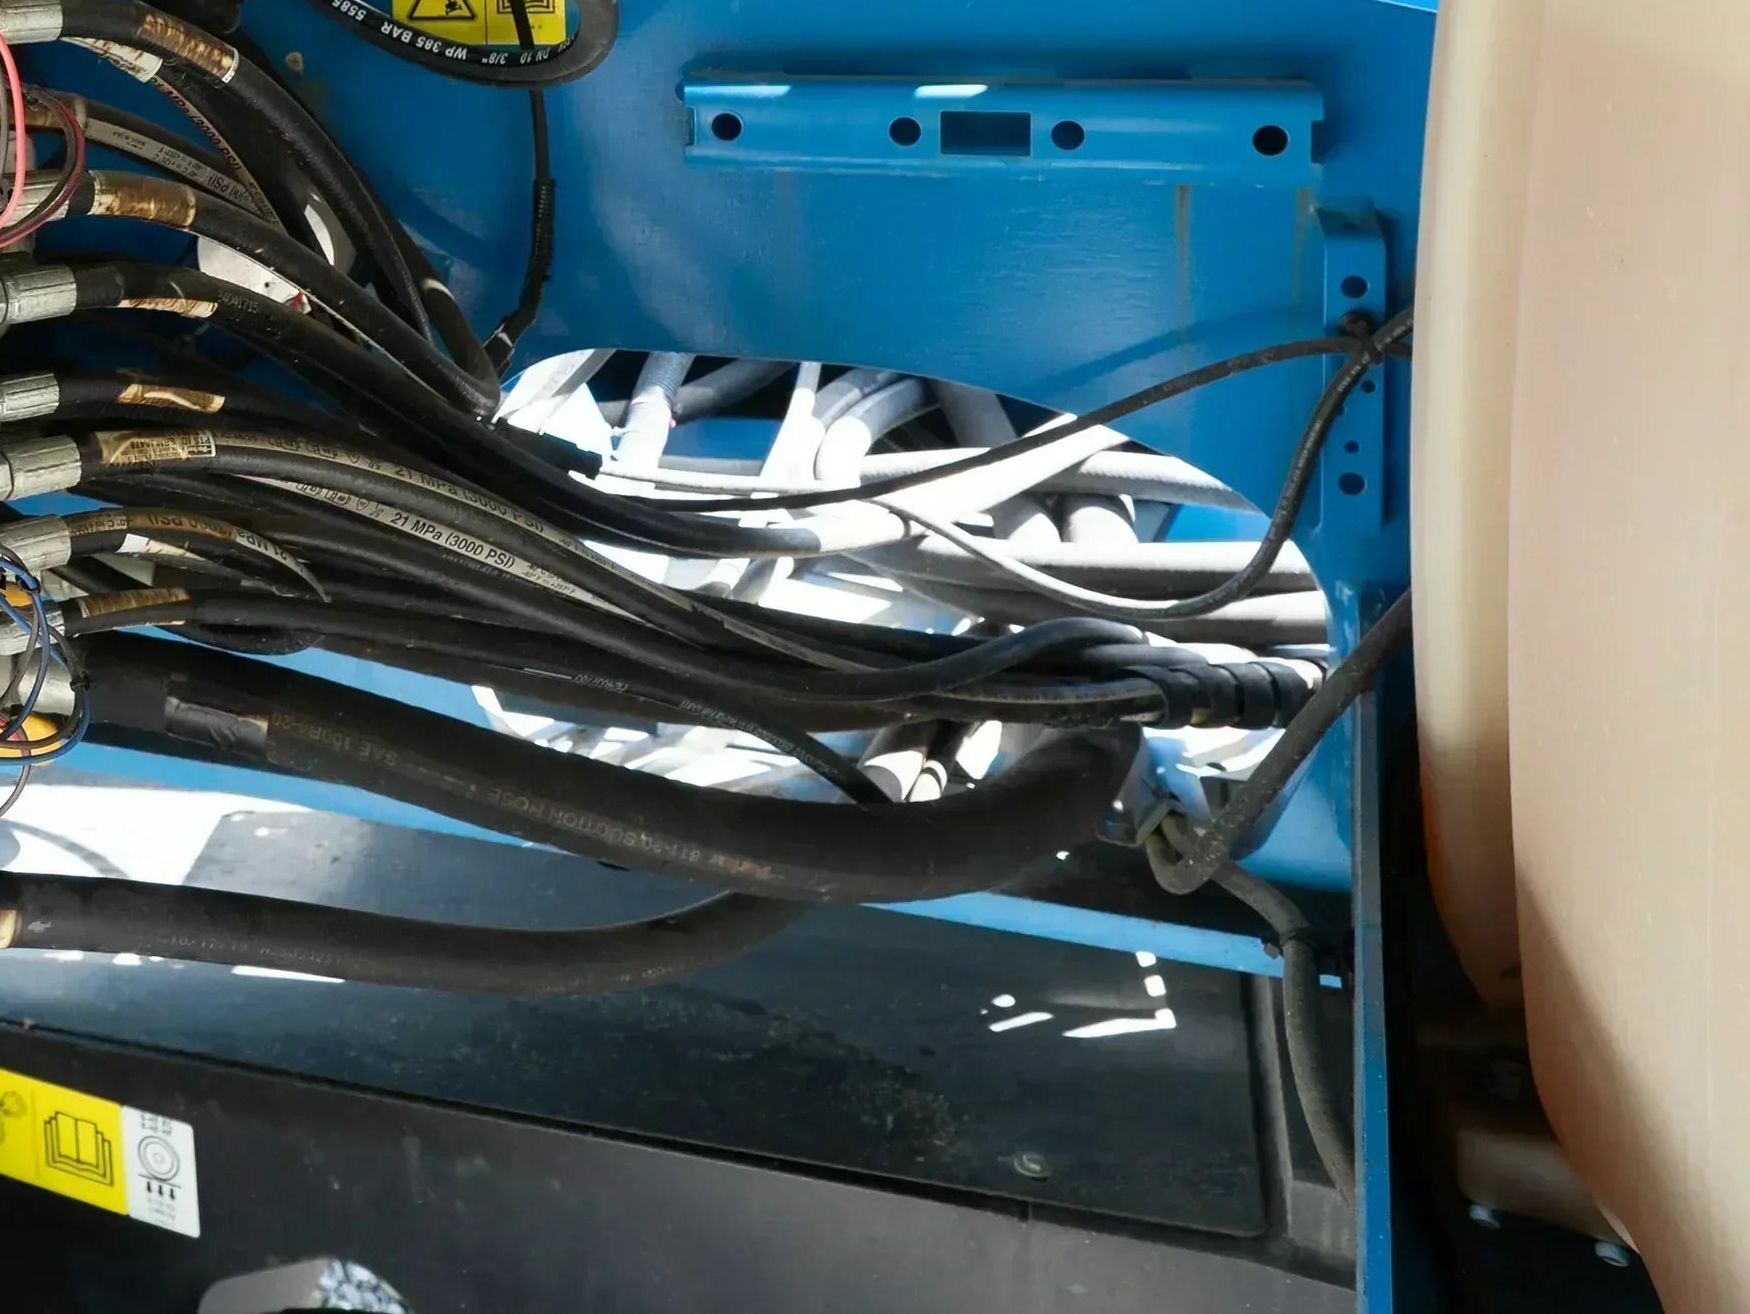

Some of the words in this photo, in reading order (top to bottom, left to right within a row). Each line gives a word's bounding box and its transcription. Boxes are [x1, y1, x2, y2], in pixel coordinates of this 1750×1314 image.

[380, 21, 411, 44] BAR
[415, 37, 442, 53] 385
[445, 47, 469, 61] WP
[390, 512, 410, 527] 21
[411, 519, 443, 541] MPa
[444, 532, 485, 557] (3000
[486, 548, 516, 569] PSI)
[358, 741, 399, 767] SAE
[486, 788, 544, 817] HOSE
[550, 809, 637, 847] SUCTION
